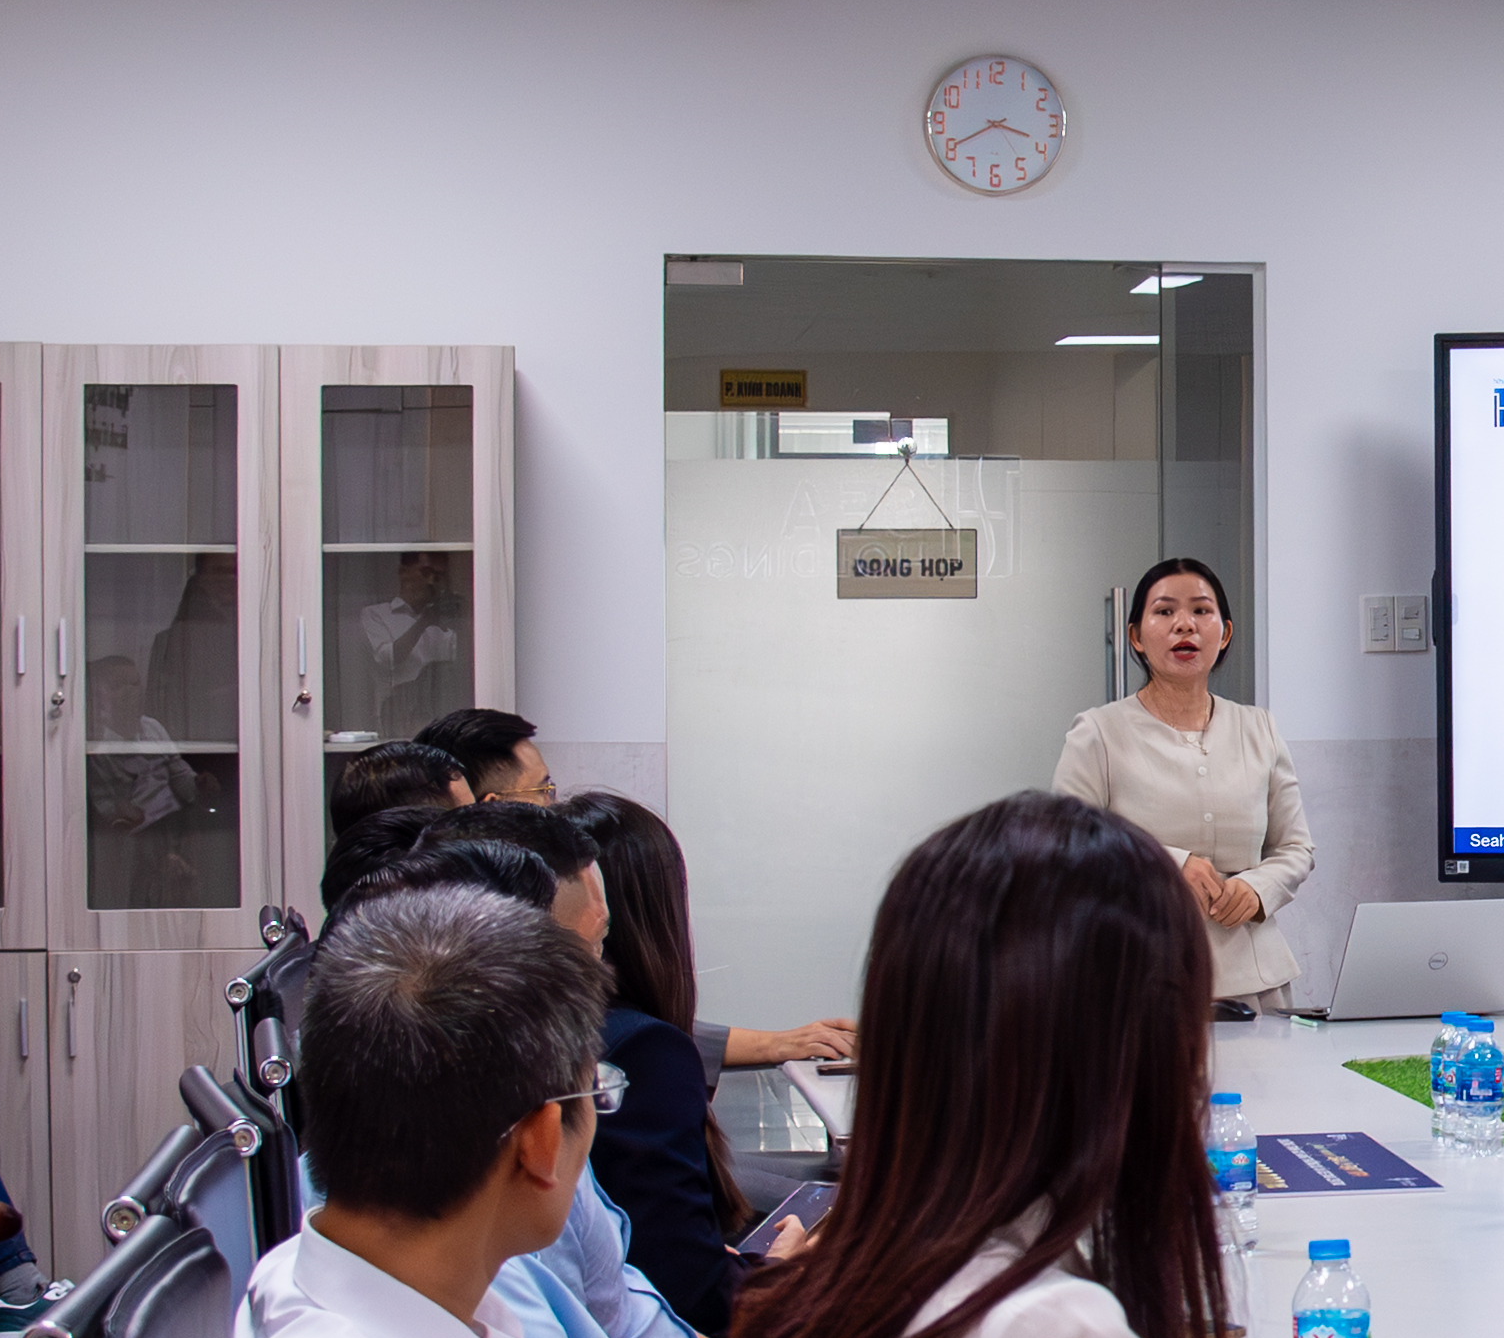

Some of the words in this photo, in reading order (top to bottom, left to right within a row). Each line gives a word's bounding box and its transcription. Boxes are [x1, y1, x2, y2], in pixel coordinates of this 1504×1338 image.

[964, 69, 981, 90] 11
[989, 61, 1006, 85] 12
[1021, 71, 1026, 91] 1
[944, 85, 960, 109] 10
[1036, 87, 1048, 111] 2
[933, 111, 945, 135] 9
[1048, 114, 1060, 138] 3
[945, 137, 957, 161] 8
[1035, 142, 1047, 163] 4
[965, 156, 976, 177] 7
[989, 164, 1001, 188] 6
[1015, 157, 1027, 181] 5
[921, 558, 964, 581] HỌP
